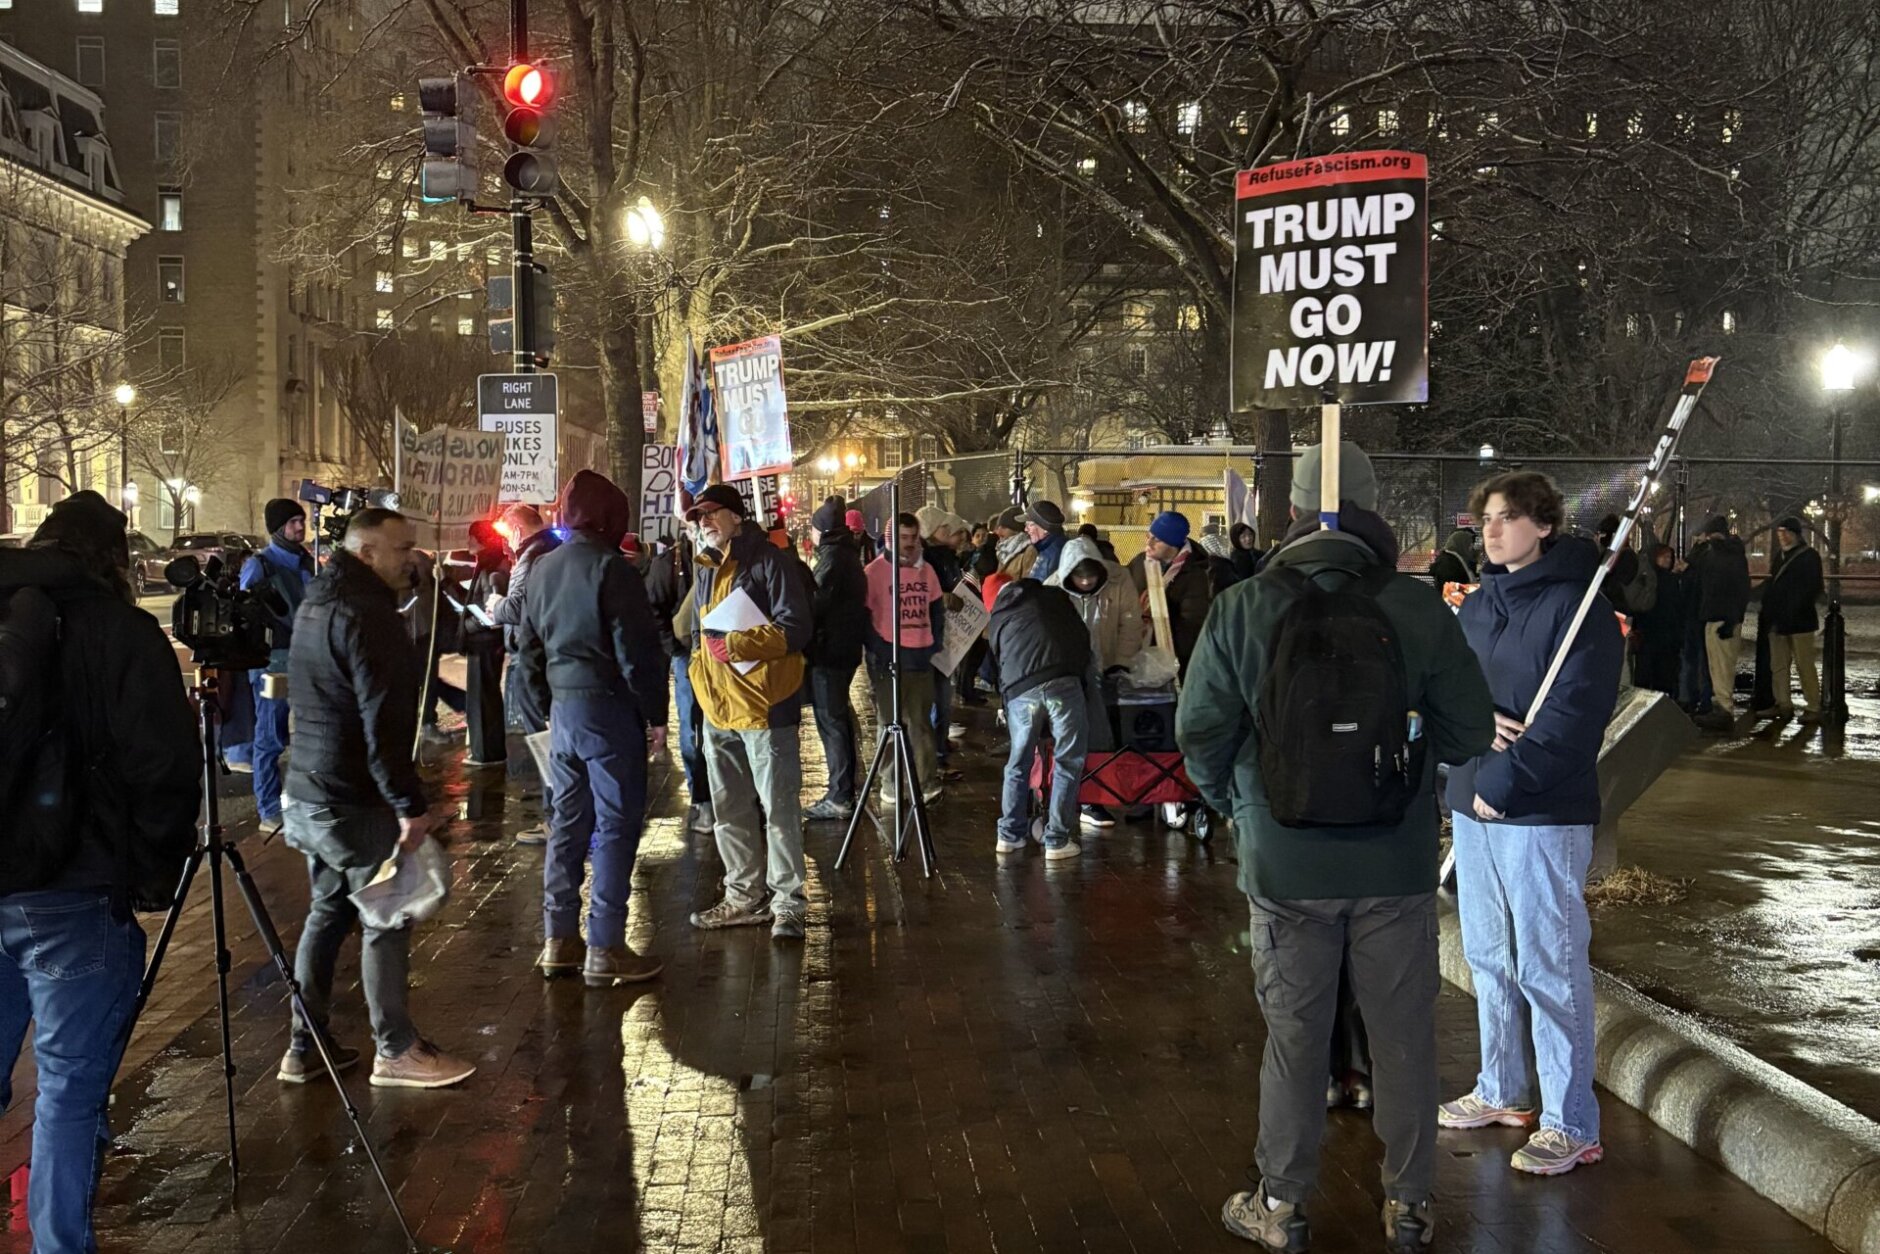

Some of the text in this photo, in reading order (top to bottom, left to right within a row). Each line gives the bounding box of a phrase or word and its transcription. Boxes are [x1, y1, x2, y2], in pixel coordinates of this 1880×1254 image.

[1248, 156, 1411, 186] RefuseFascism.org
[1245, 192, 1415, 249] TRUMP
[1259, 242, 1397, 294] MUST
[1290, 294, 1362, 338] GO
[715, 354, 779, 388] TRUMP
[1264, 340, 1396, 389] NOW!
[502, 382, 533, 394] RIGHT
[723, 381, 775, 412] MUST
[504, 398, 532, 409] LANE
[739, 411, 766, 435] GO
[506, 437, 542, 450] IKES
[503, 470, 540, 480] AM-7PM
[889, 582, 928, 594] EACE
[902, 608, 926, 619] RAN
